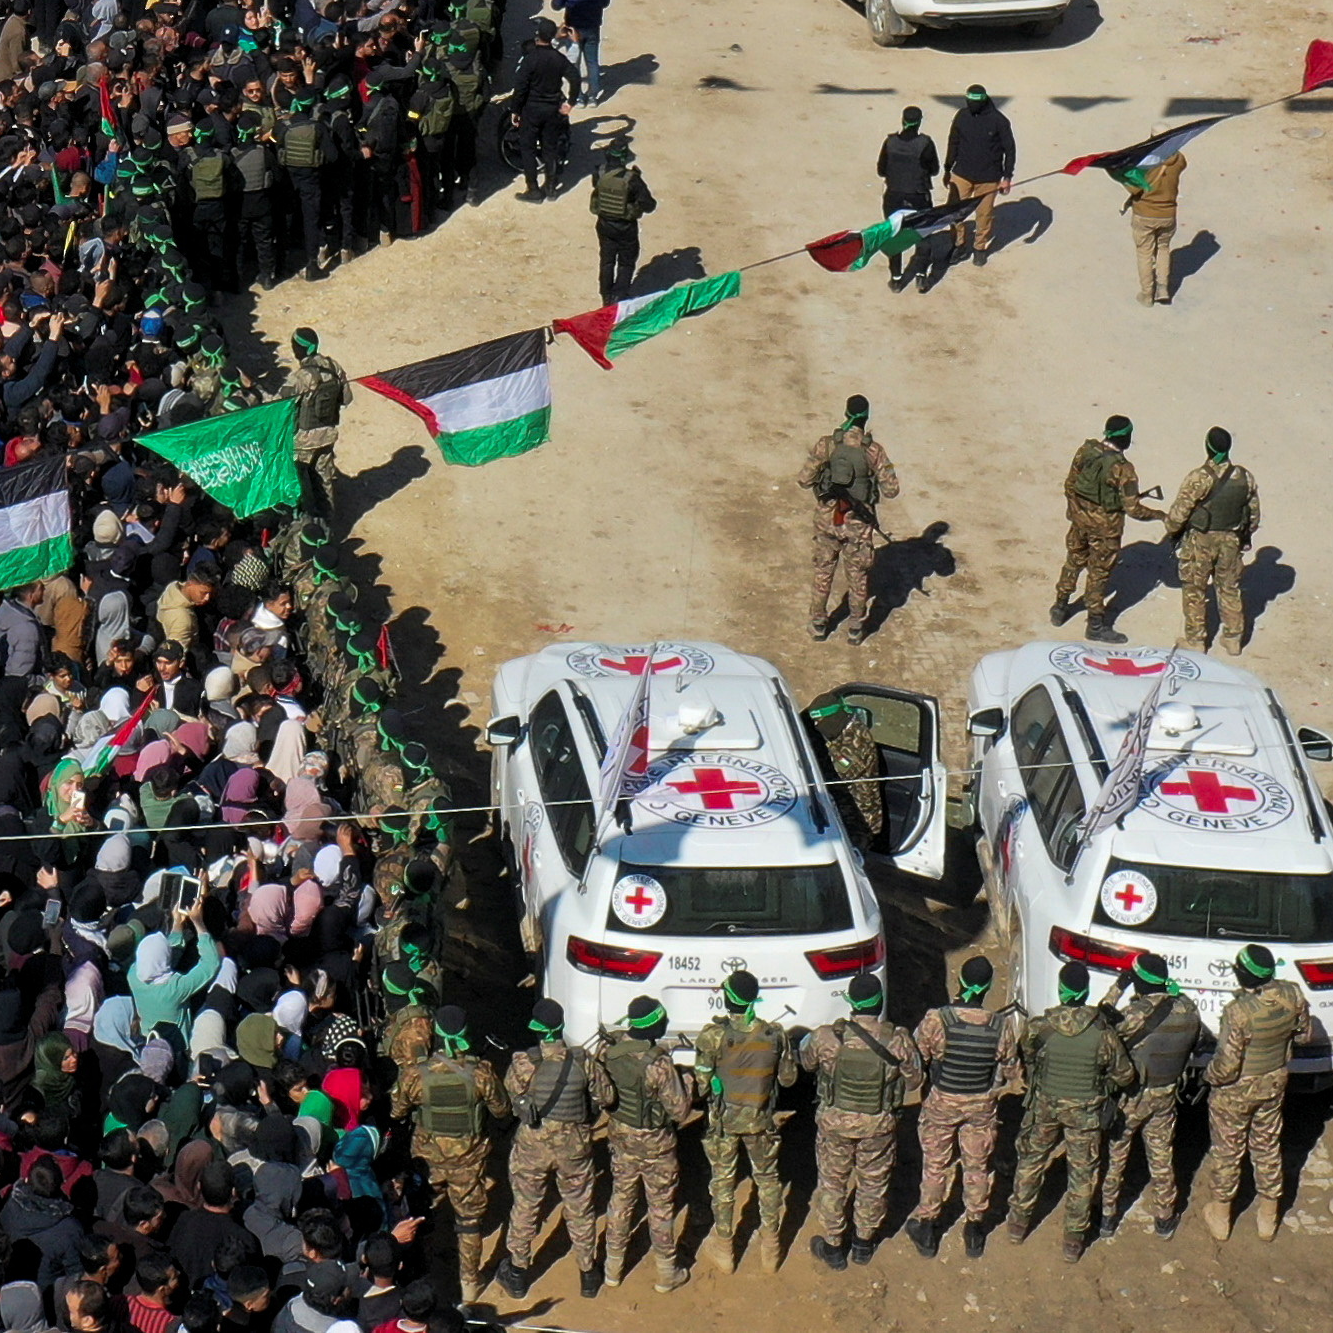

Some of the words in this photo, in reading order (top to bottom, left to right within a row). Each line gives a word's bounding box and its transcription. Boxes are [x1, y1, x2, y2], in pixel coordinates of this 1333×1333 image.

[664, 754, 793, 808] INTERNATIONAL
[1155, 756, 1289, 815] INTERNATIONAL
[675, 808, 772, 827] GENEVE
[1167, 810, 1269, 831] GENEVE
[668, 956, 701, 971] 18452
